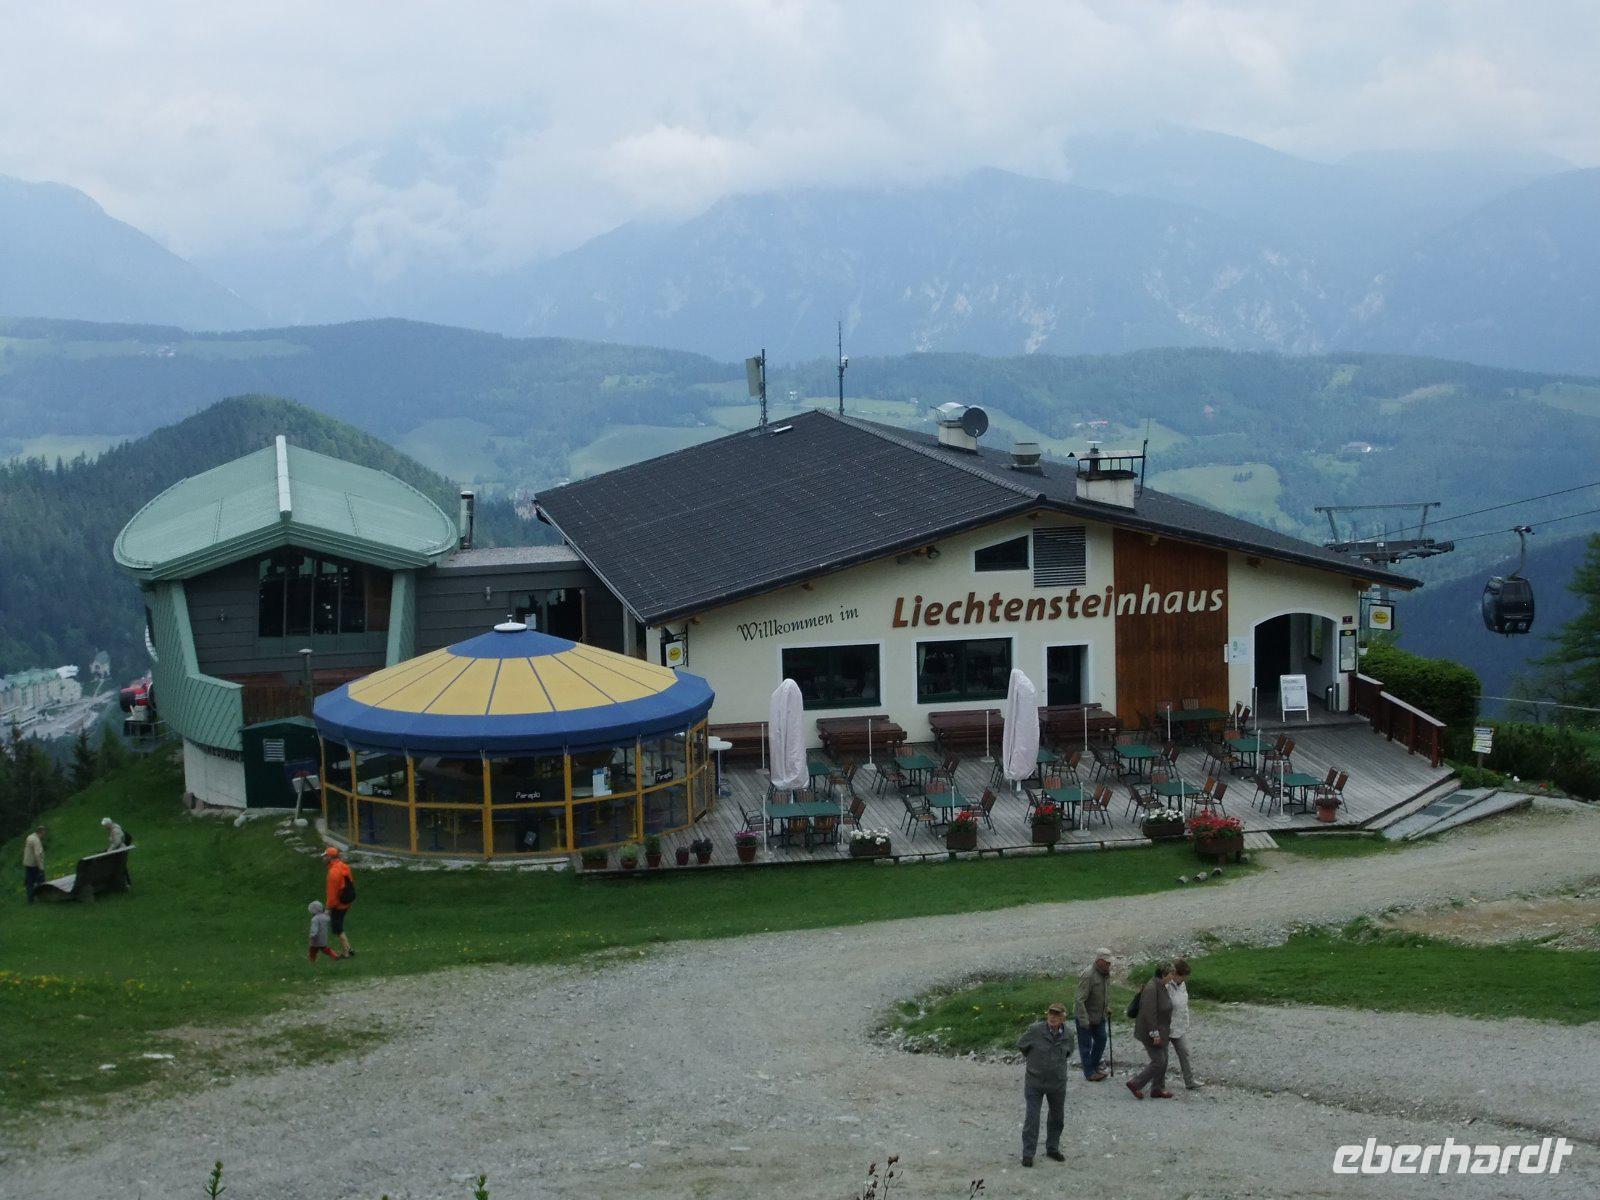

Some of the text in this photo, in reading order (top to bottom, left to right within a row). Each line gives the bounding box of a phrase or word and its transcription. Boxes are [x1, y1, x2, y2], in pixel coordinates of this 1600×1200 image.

[736, 605, 859, 642] Willkommen im
[892, 584, 1224, 628] Liechtensteinhaus
